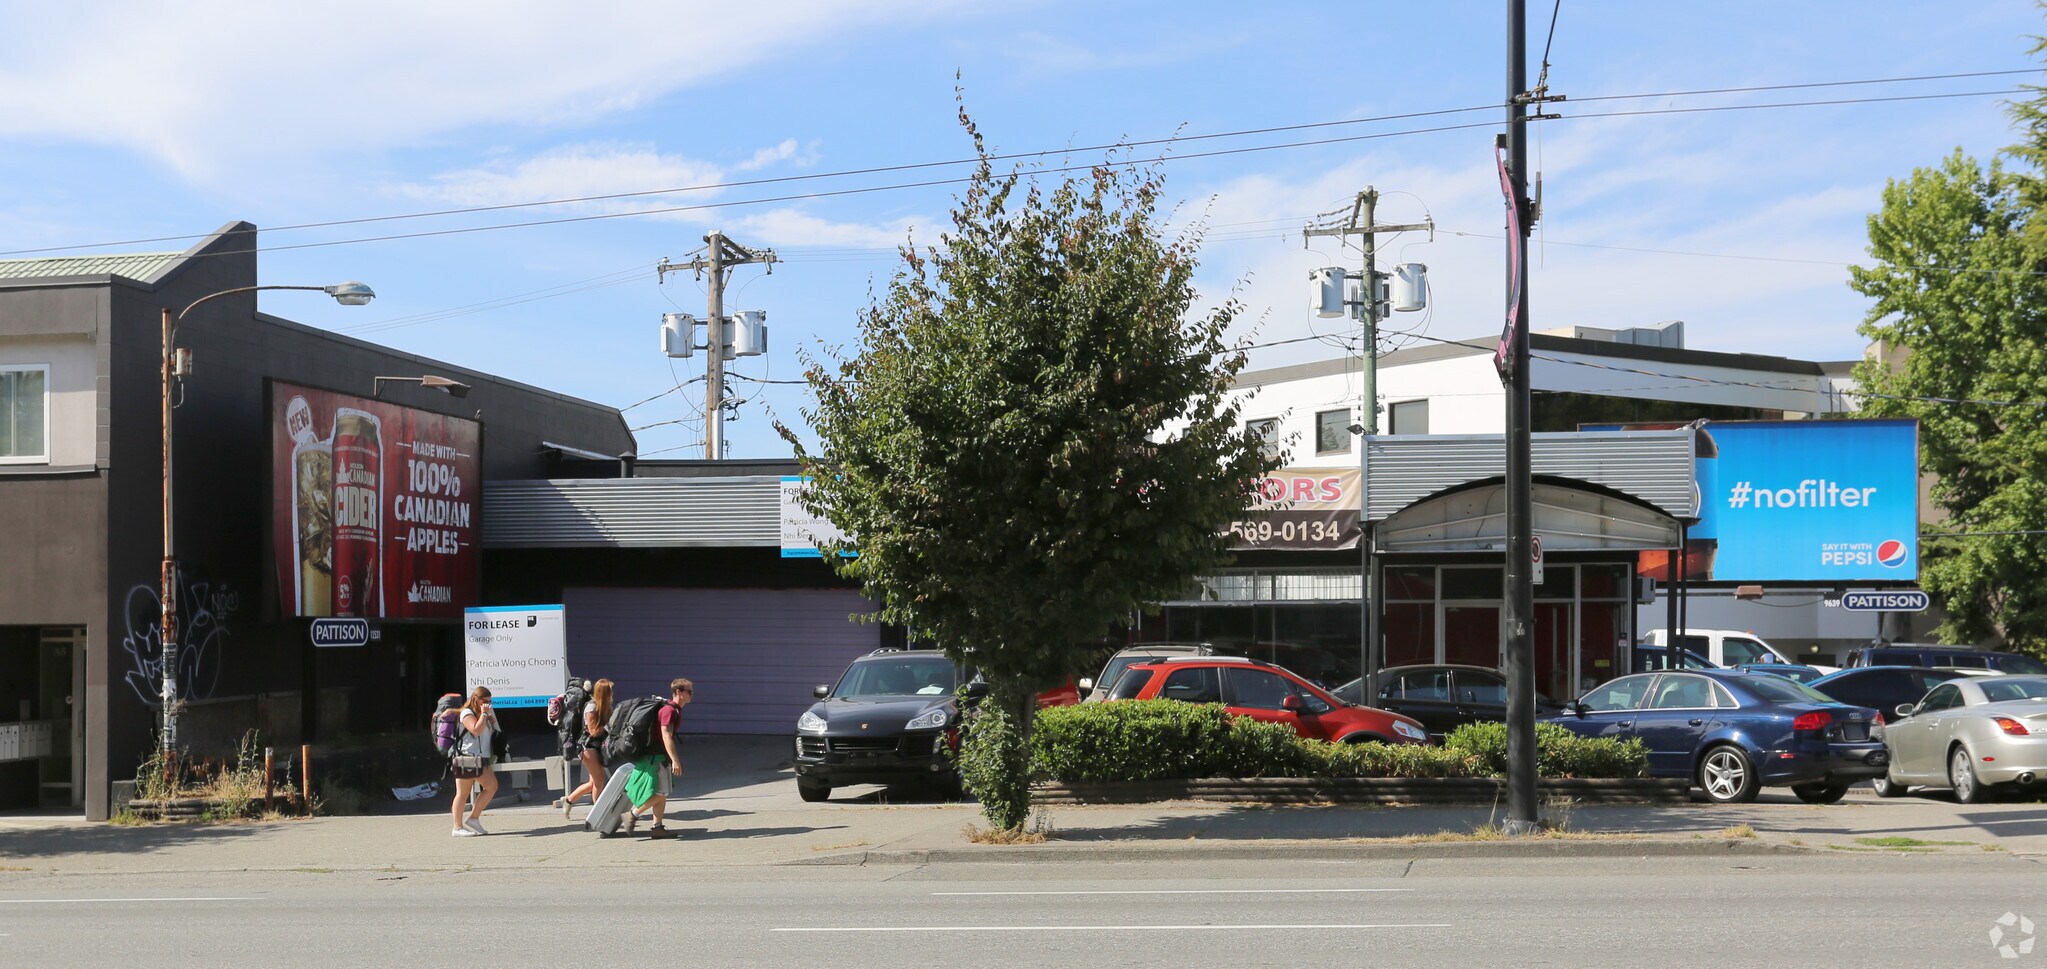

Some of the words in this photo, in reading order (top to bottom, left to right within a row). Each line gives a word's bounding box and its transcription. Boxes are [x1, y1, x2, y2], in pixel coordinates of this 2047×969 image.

[288, 405, 310, 436] NEW
[412, 441, 435, 457] MADE
[436, 445, 456, 461] WITH
[408, 459, 460, 497] 100%
[1259, 478, 1341, 501] ORS
[1728, 479, 1877, 508] #nofilter
[335, 486, 376, 530] CIDER
[395, 494, 470, 528] CANADIAN
[407, 527, 458, 555] APPLES
[1822, 552, 1872, 565] PEPSI
[420, 585, 451, 602] CANADIAN
[1849, 596, 1921, 607] PATTISON
[316, 625, 364, 640] PATTISON
[469, 621, 488, 630] FOR
[490, 620, 520, 629] LEASE
[468, 635, 495, 644] Garage
[496, 634, 513, 643] Only
[469, 659, 500, 668] Patricia
[501, 659, 526, 669] Wong
[528, 657, 557, 667] Chong
[487, 677, 511, 685] Denis
